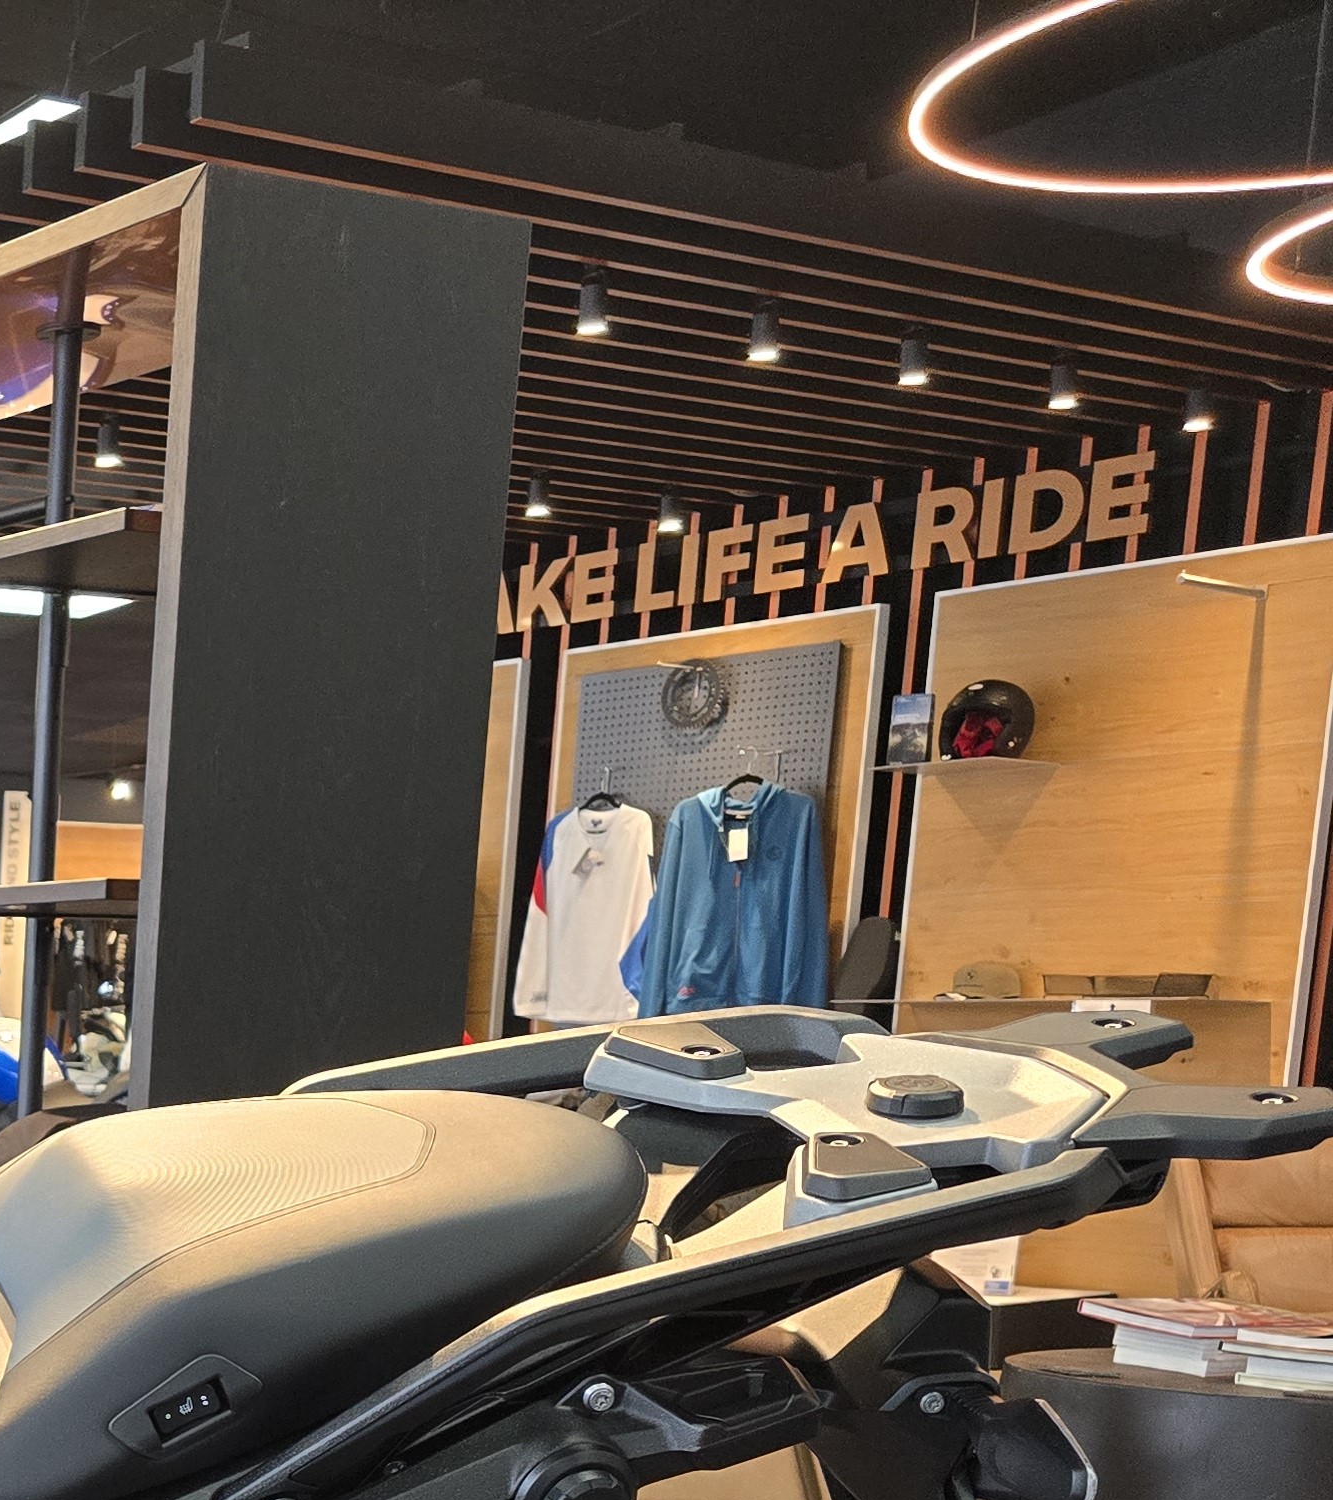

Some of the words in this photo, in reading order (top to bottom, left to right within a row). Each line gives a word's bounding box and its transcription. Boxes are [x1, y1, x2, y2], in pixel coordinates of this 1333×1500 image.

[497, 548, 619, 635] KE
[633, 512, 810, 614] LIFE
[820, 501, 890, 583] A
[909, 450, 1156, 571] RIDE
[7, 801, 22, 857] STYLE
